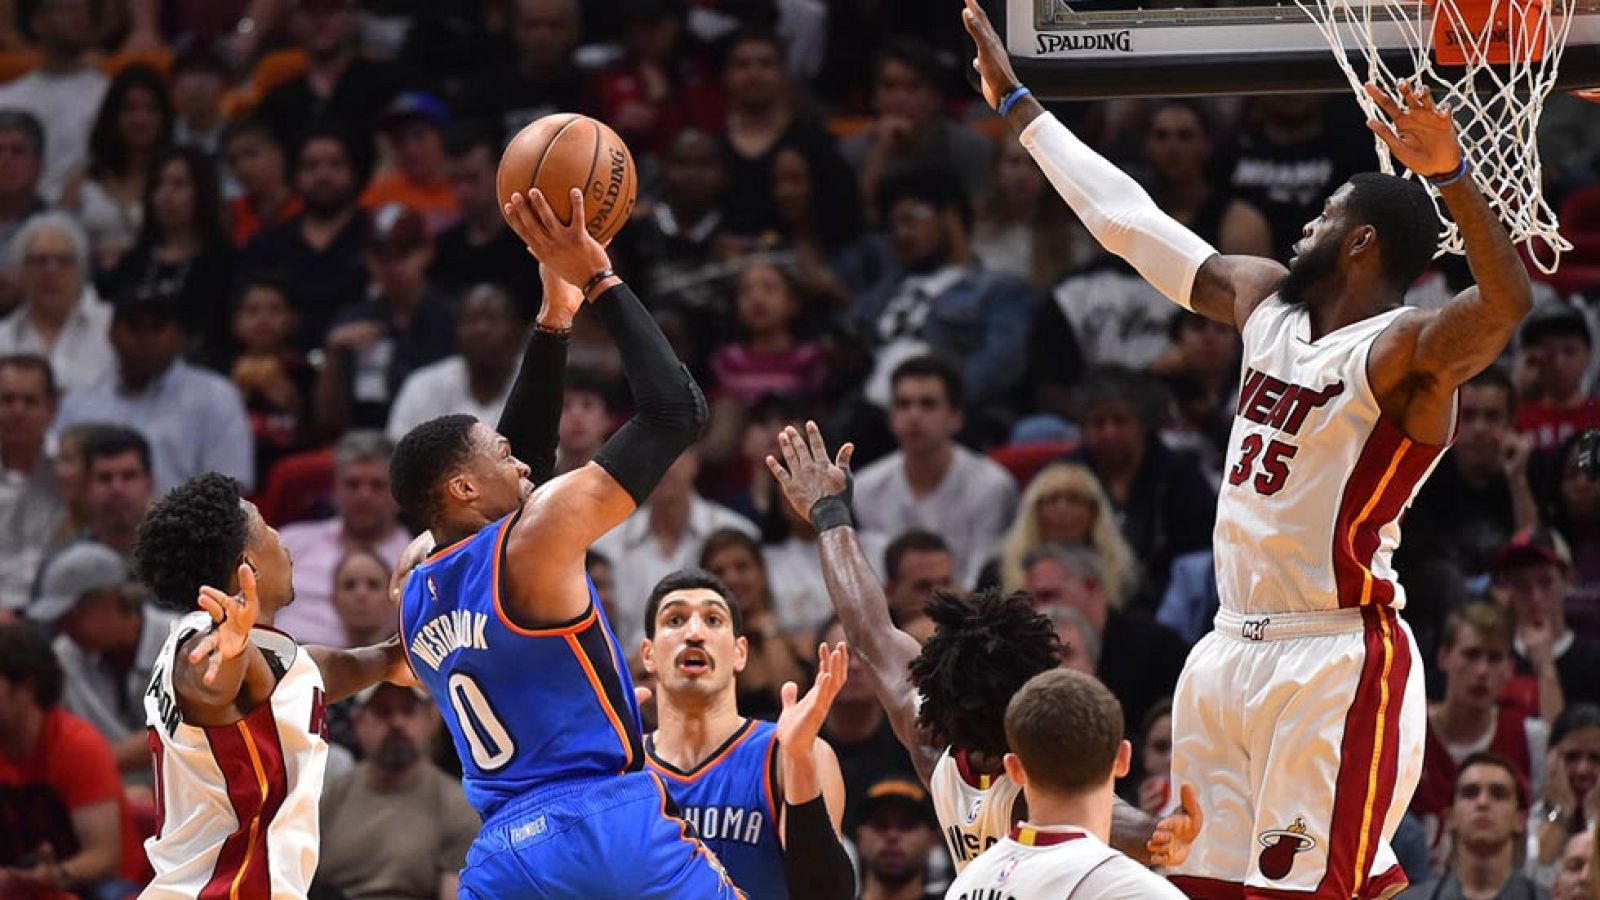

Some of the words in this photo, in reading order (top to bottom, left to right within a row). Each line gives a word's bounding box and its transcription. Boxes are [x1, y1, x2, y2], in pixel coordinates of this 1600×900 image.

[1036, 30, 1132, 55] SPALDING
[1228, 432, 1299, 496] 35
[410, 608, 489, 672] WESTBOK
[448, 671, 516, 771] 0
[681, 805, 764, 845] HOMA
